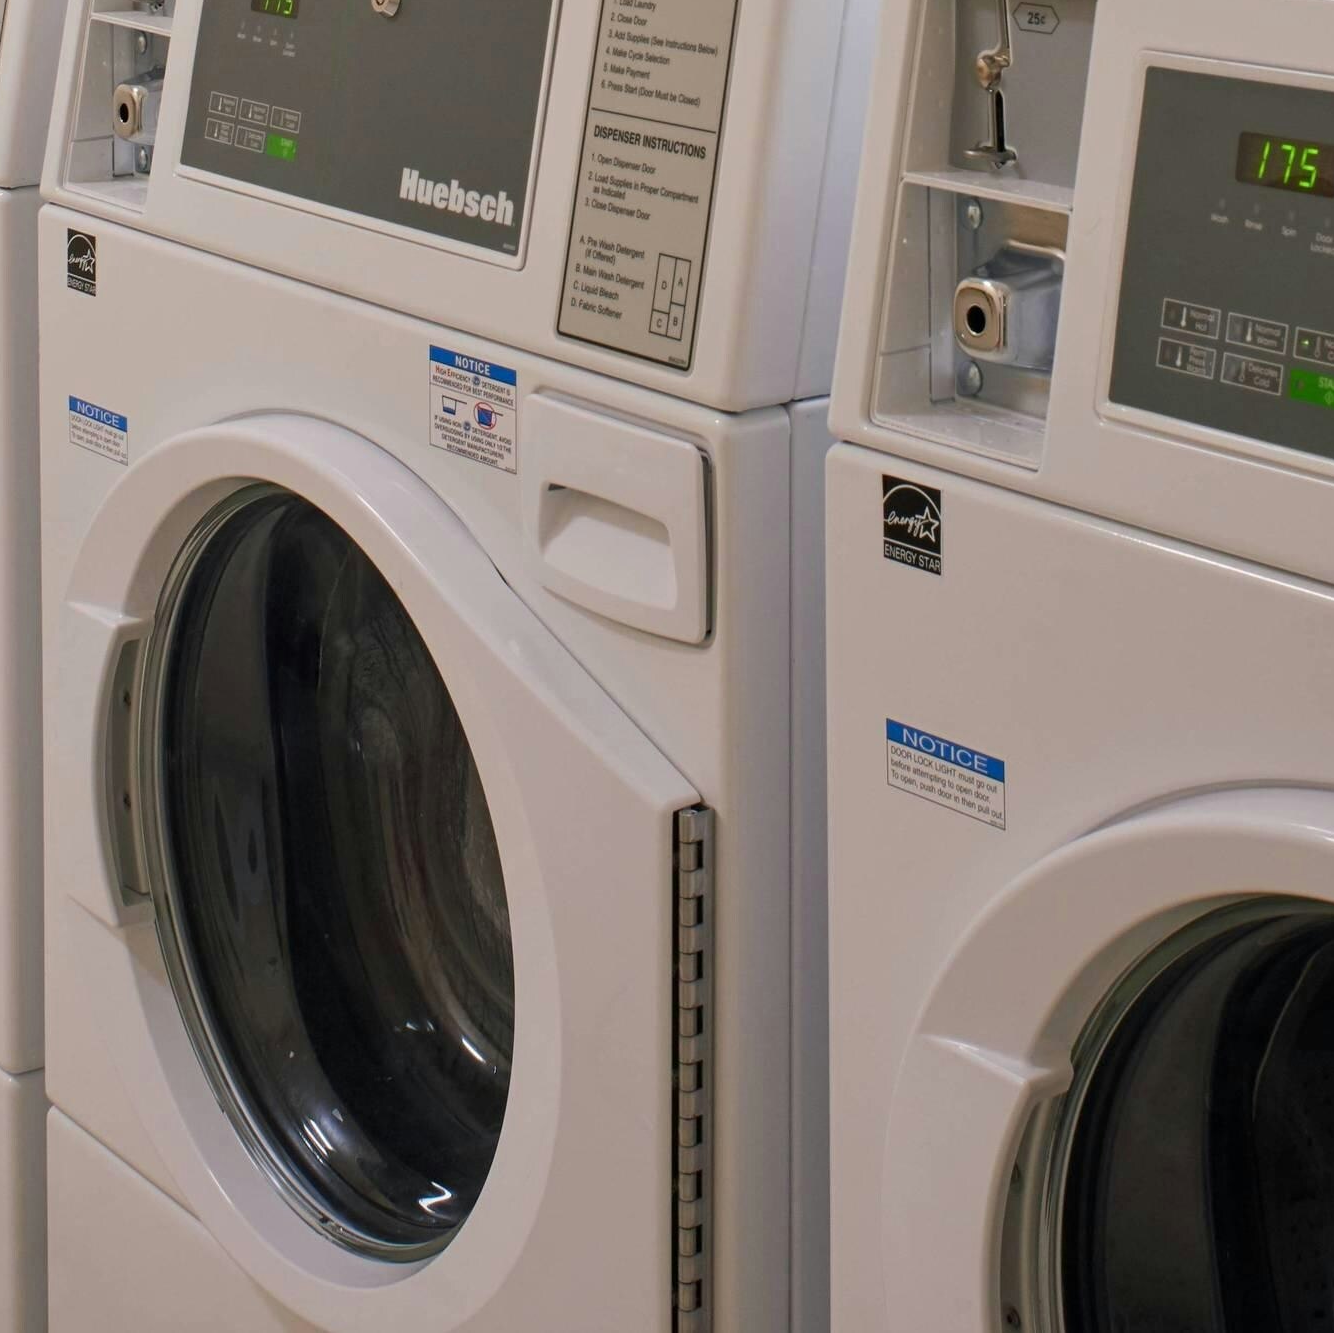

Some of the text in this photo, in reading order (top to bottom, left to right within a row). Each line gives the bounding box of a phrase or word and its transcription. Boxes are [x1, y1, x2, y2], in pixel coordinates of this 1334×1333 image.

[594, 125, 706, 159] DISPENSER INSTRUCTIONS
[1258, 141, 1319, 188] 175
[399, 167, 514, 226] Huebsch
[455, 355, 490, 376] NOTICE
[77, 400, 120, 427] NOTICE
[885, 544, 940, 572] ENERGY STAR
[903, 728, 988, 774] NOTICE
